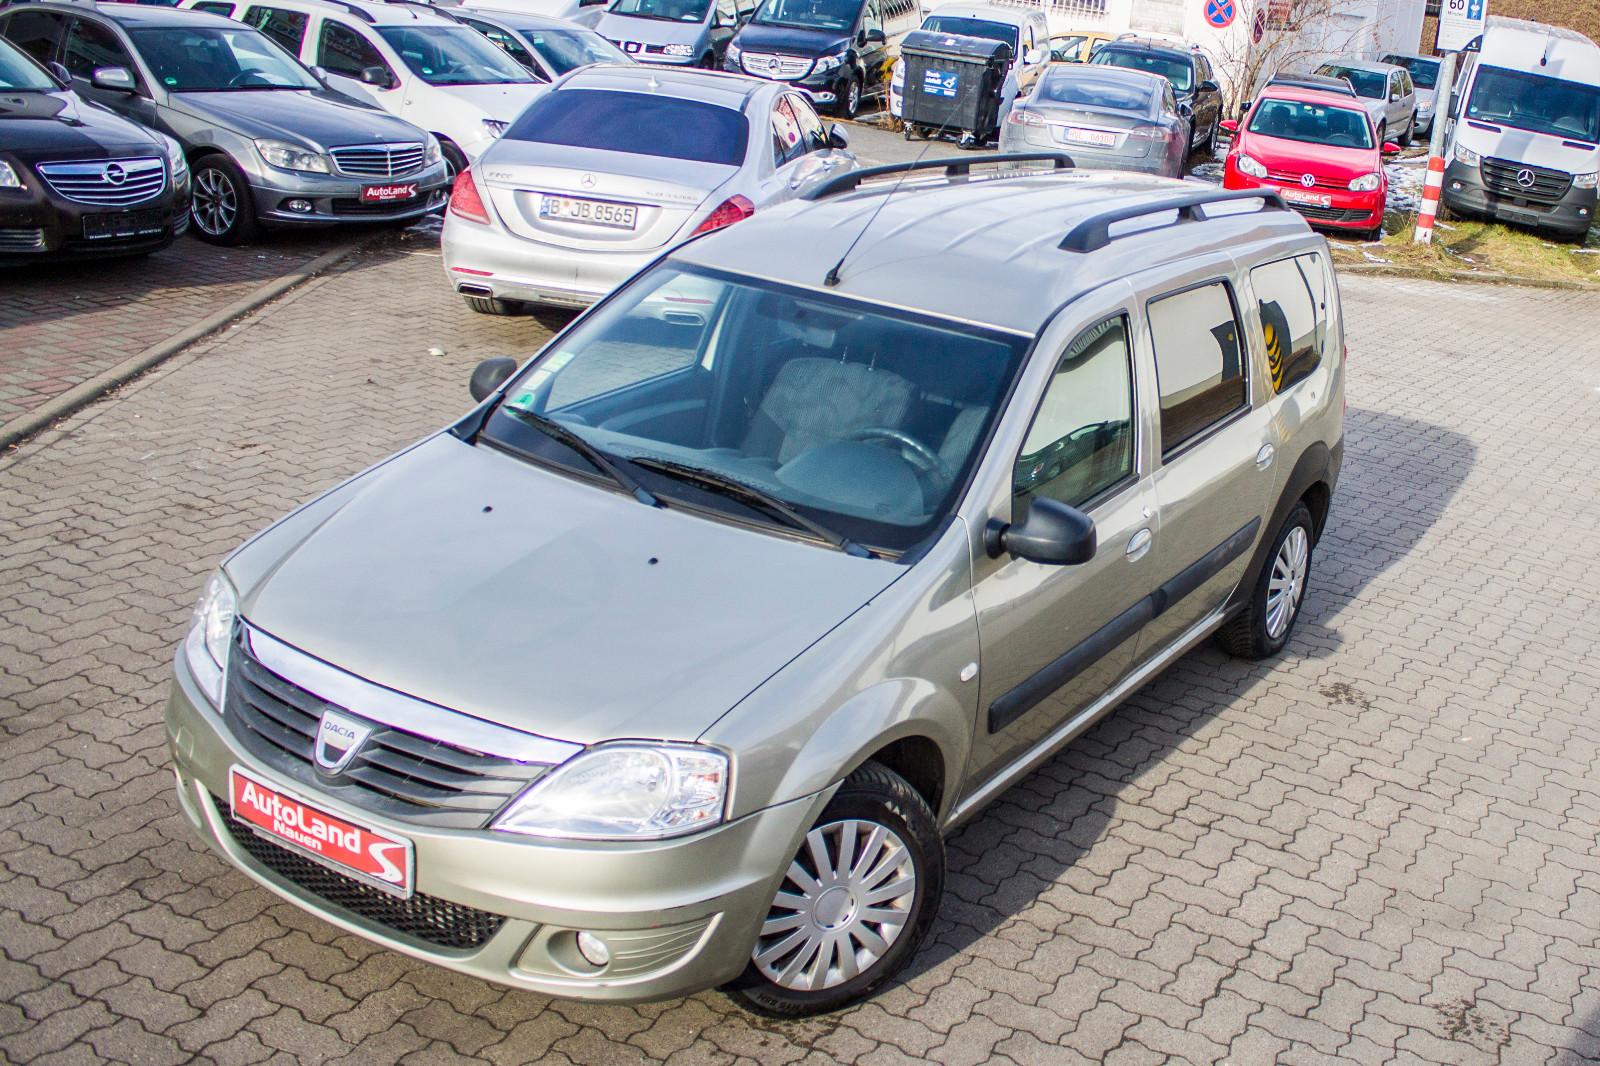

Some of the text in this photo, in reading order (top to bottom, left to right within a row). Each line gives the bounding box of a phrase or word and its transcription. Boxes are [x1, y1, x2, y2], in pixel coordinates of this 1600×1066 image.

[1449, 0, 1465, 10] 60
[366, 185, 408, 197] AutoLand
[1284, 190, 1320, 201] AutoLand
[550, 199, 633, 224] B JB 8565
[323, 720, 356, 741] DACIA
[241, 781, 361, 854] AutoLand
[273, 819, 323, 851] Nauen
